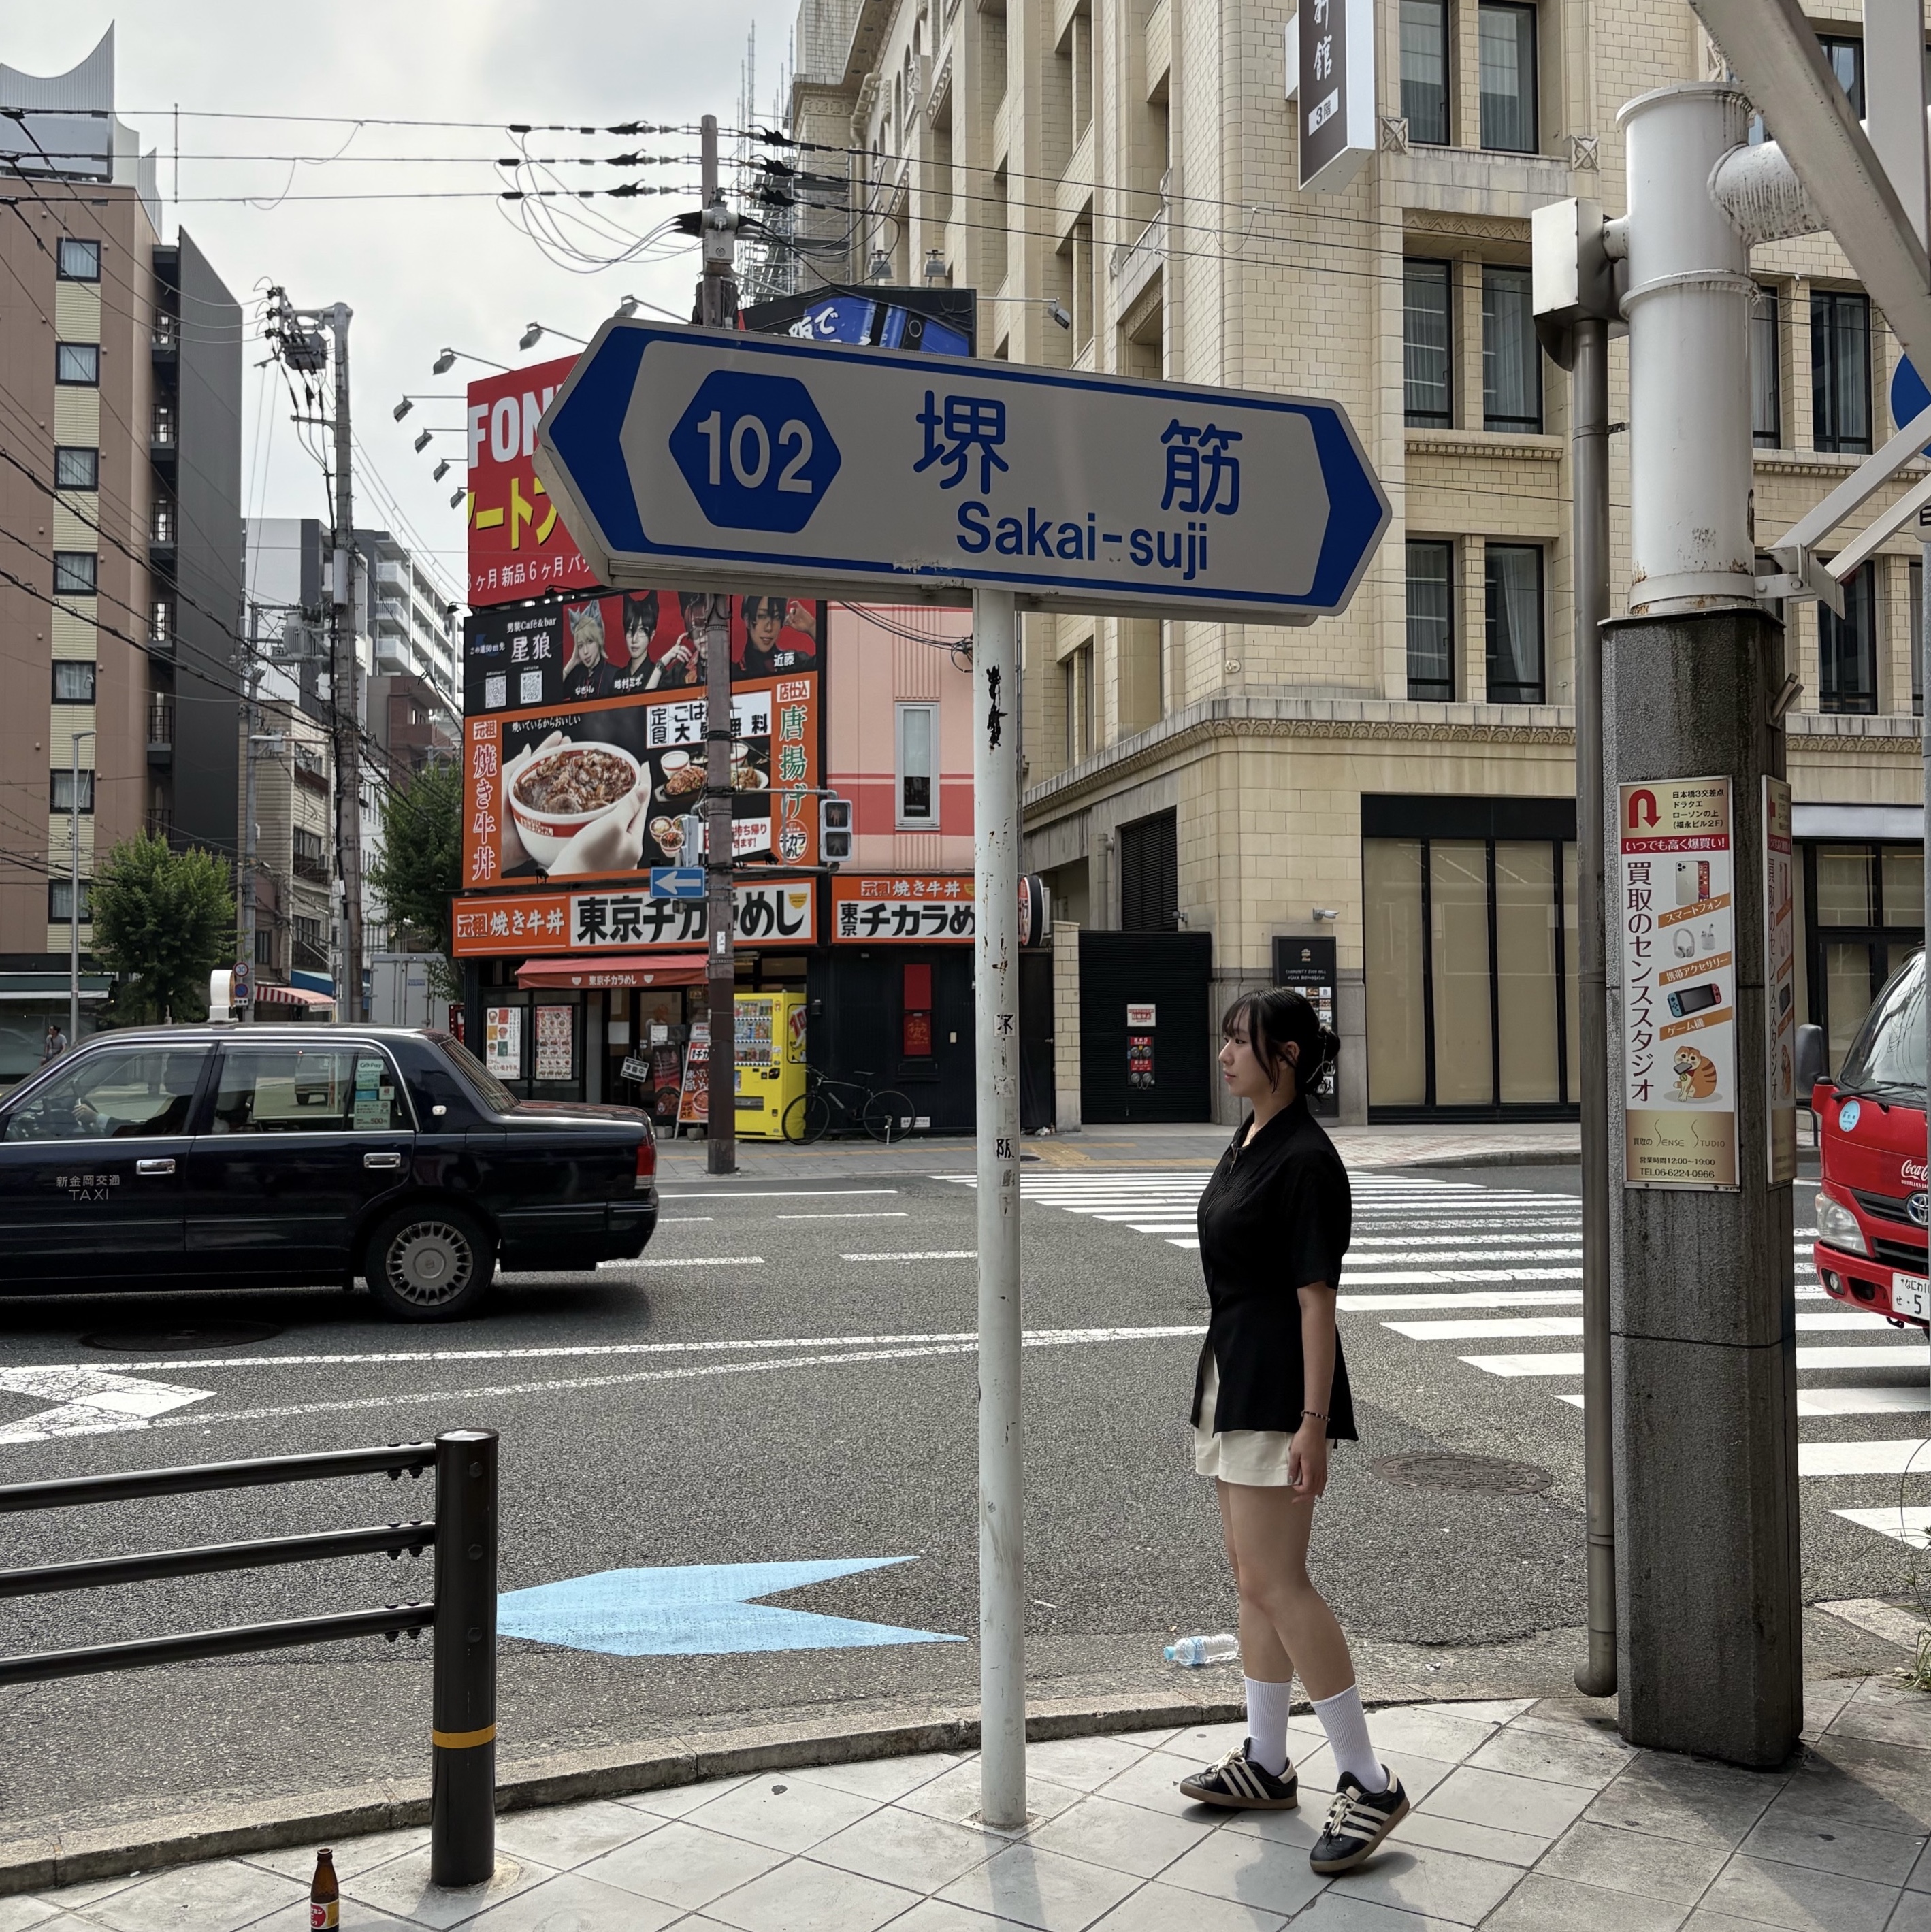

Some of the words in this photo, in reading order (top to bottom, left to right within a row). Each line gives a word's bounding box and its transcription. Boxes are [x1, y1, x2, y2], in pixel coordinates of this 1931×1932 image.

[1316, 100, 1331, 125] 3階
[773, 307, 839, 340] 阪で
[468, 384, 562, 469] FON
[697, 411, 813, 494] 102
[468, 477, 559, 551] ートフ
[956, 501, 1208, 580] Sakai-suji
[511, 632, 552, 663] 星狼
[774, 653, 794, 667] 近藤
[780, 681, 807, 700] 店仕込
[675, 703, 708, 722] ごは
[474, 721, 496, 740] 元祖
[651, 708, 667, 744] 定食
[779, 704, 808, 819] 唐揚げ
[1672, 789, 1724, 799] 日本橋3交差点
[472, 744, 497, 880] 焼き牛丼
[1673, 810, 1719, 819] ローソンの上
[1673, 819, 1723, 830] (福永ビル2F)
[1625, 837, 1725, 851] いつでも高く爆買い!
[893, 880, 960, 898] 焼き牛丼
[457, 913, 487, 938] 元祖
[490, 908, 564, 937] 焼き牛丼
[577, 890, 805, 945] 東京チカめし
[840, 903, 858, 936] 東京
[1666, 899, 1722, 923] スマートフォン
[589, 974, 637, 986] 東京チカラめし
[1666, 957, 1728, 982] 携帯アクセサリー
[1627, 862, 1654, 1102] 買取のセンススタジオ
[1667, 1018, 1705, 1036] ゲーム機
[1634, 1137, 1653, 1146] 買取の
[1654, 1118, 1685, 1147] SENSE
[1691, 1119, 1725, 1149] STUDIO
[56, 1175, 120, 1187] 新金岡交通
[1640, 1168, 1715, 1179] TEL06-6224-0966
[69, 1188, 108, 1200] TAXI
[1896, 1296, 1902, 1305] せ
